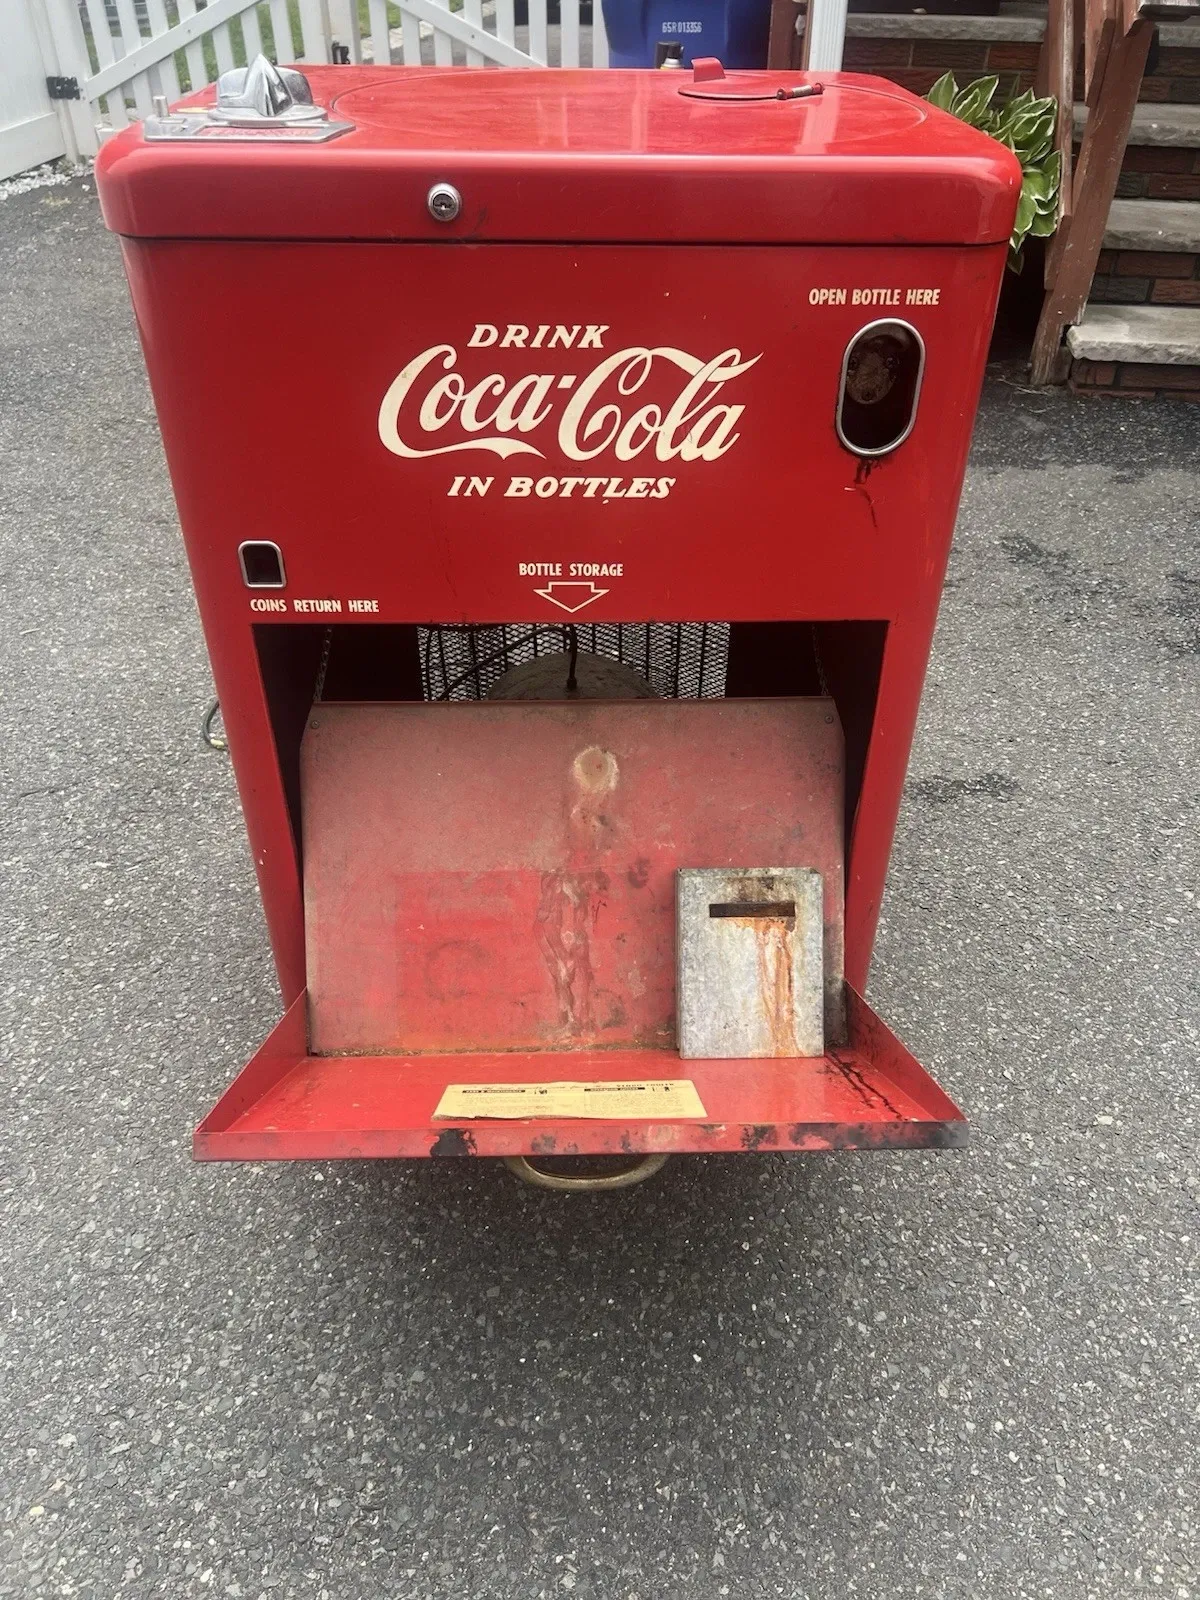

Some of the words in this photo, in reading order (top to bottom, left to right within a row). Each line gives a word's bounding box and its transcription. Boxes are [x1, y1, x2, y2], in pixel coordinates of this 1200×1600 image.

[808, 288, 847, 305] OPEN
[852, 288, 901, 306] BOTTLE
[906, 288, 941, 306] HERE
[467, 324, 610, 349] DRINK
[377, 344, 764, 462] Coca-Cola
[447, 476, 495, 497] IN
[504, 476, 676, 499] BOTTLES
[518, 562, 562, 576] BOTTLE
[569, 563, 624, 577] STORAGE
[250, 599, 287, 612] COINS
[293, 599, 342, 613] RETURN
[348, 600, 380, 613] HERE
